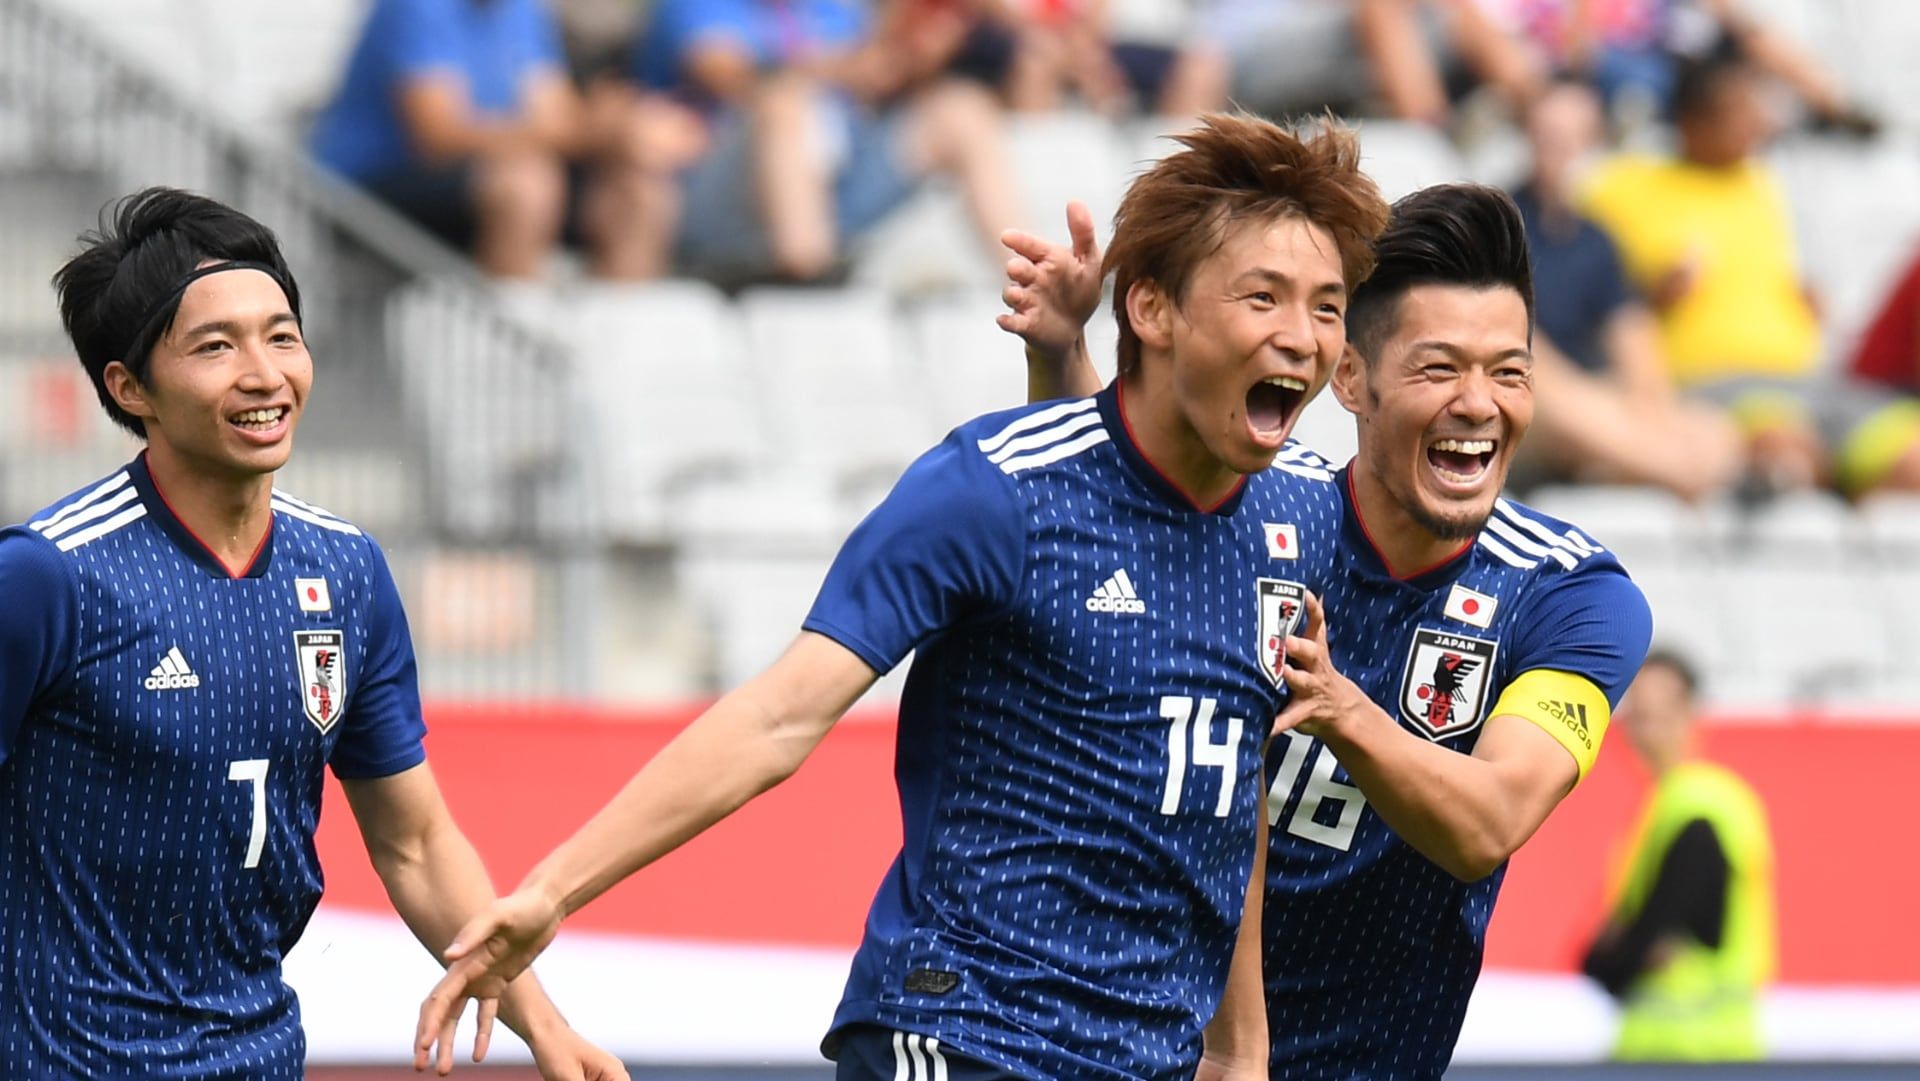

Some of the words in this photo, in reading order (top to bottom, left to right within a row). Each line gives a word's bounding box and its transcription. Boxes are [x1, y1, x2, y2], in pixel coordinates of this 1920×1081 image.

[1271, 584, 1299, 597] JAPAN
[1085, 593, 1146, 614] adidas
[307, 635, 333, 644] JAPAN
[1433, 636, 1476, 652] JAPAN
[144, 671, 200, 690] adidas
[1420, 702, 1456, 723] JFA
[1537, 701, 1592, 750] adidas
[1160, 696, 1244, 817] 14
[1267, 728, 1367, 852] 16
[228, 759, 270, 868] 7
